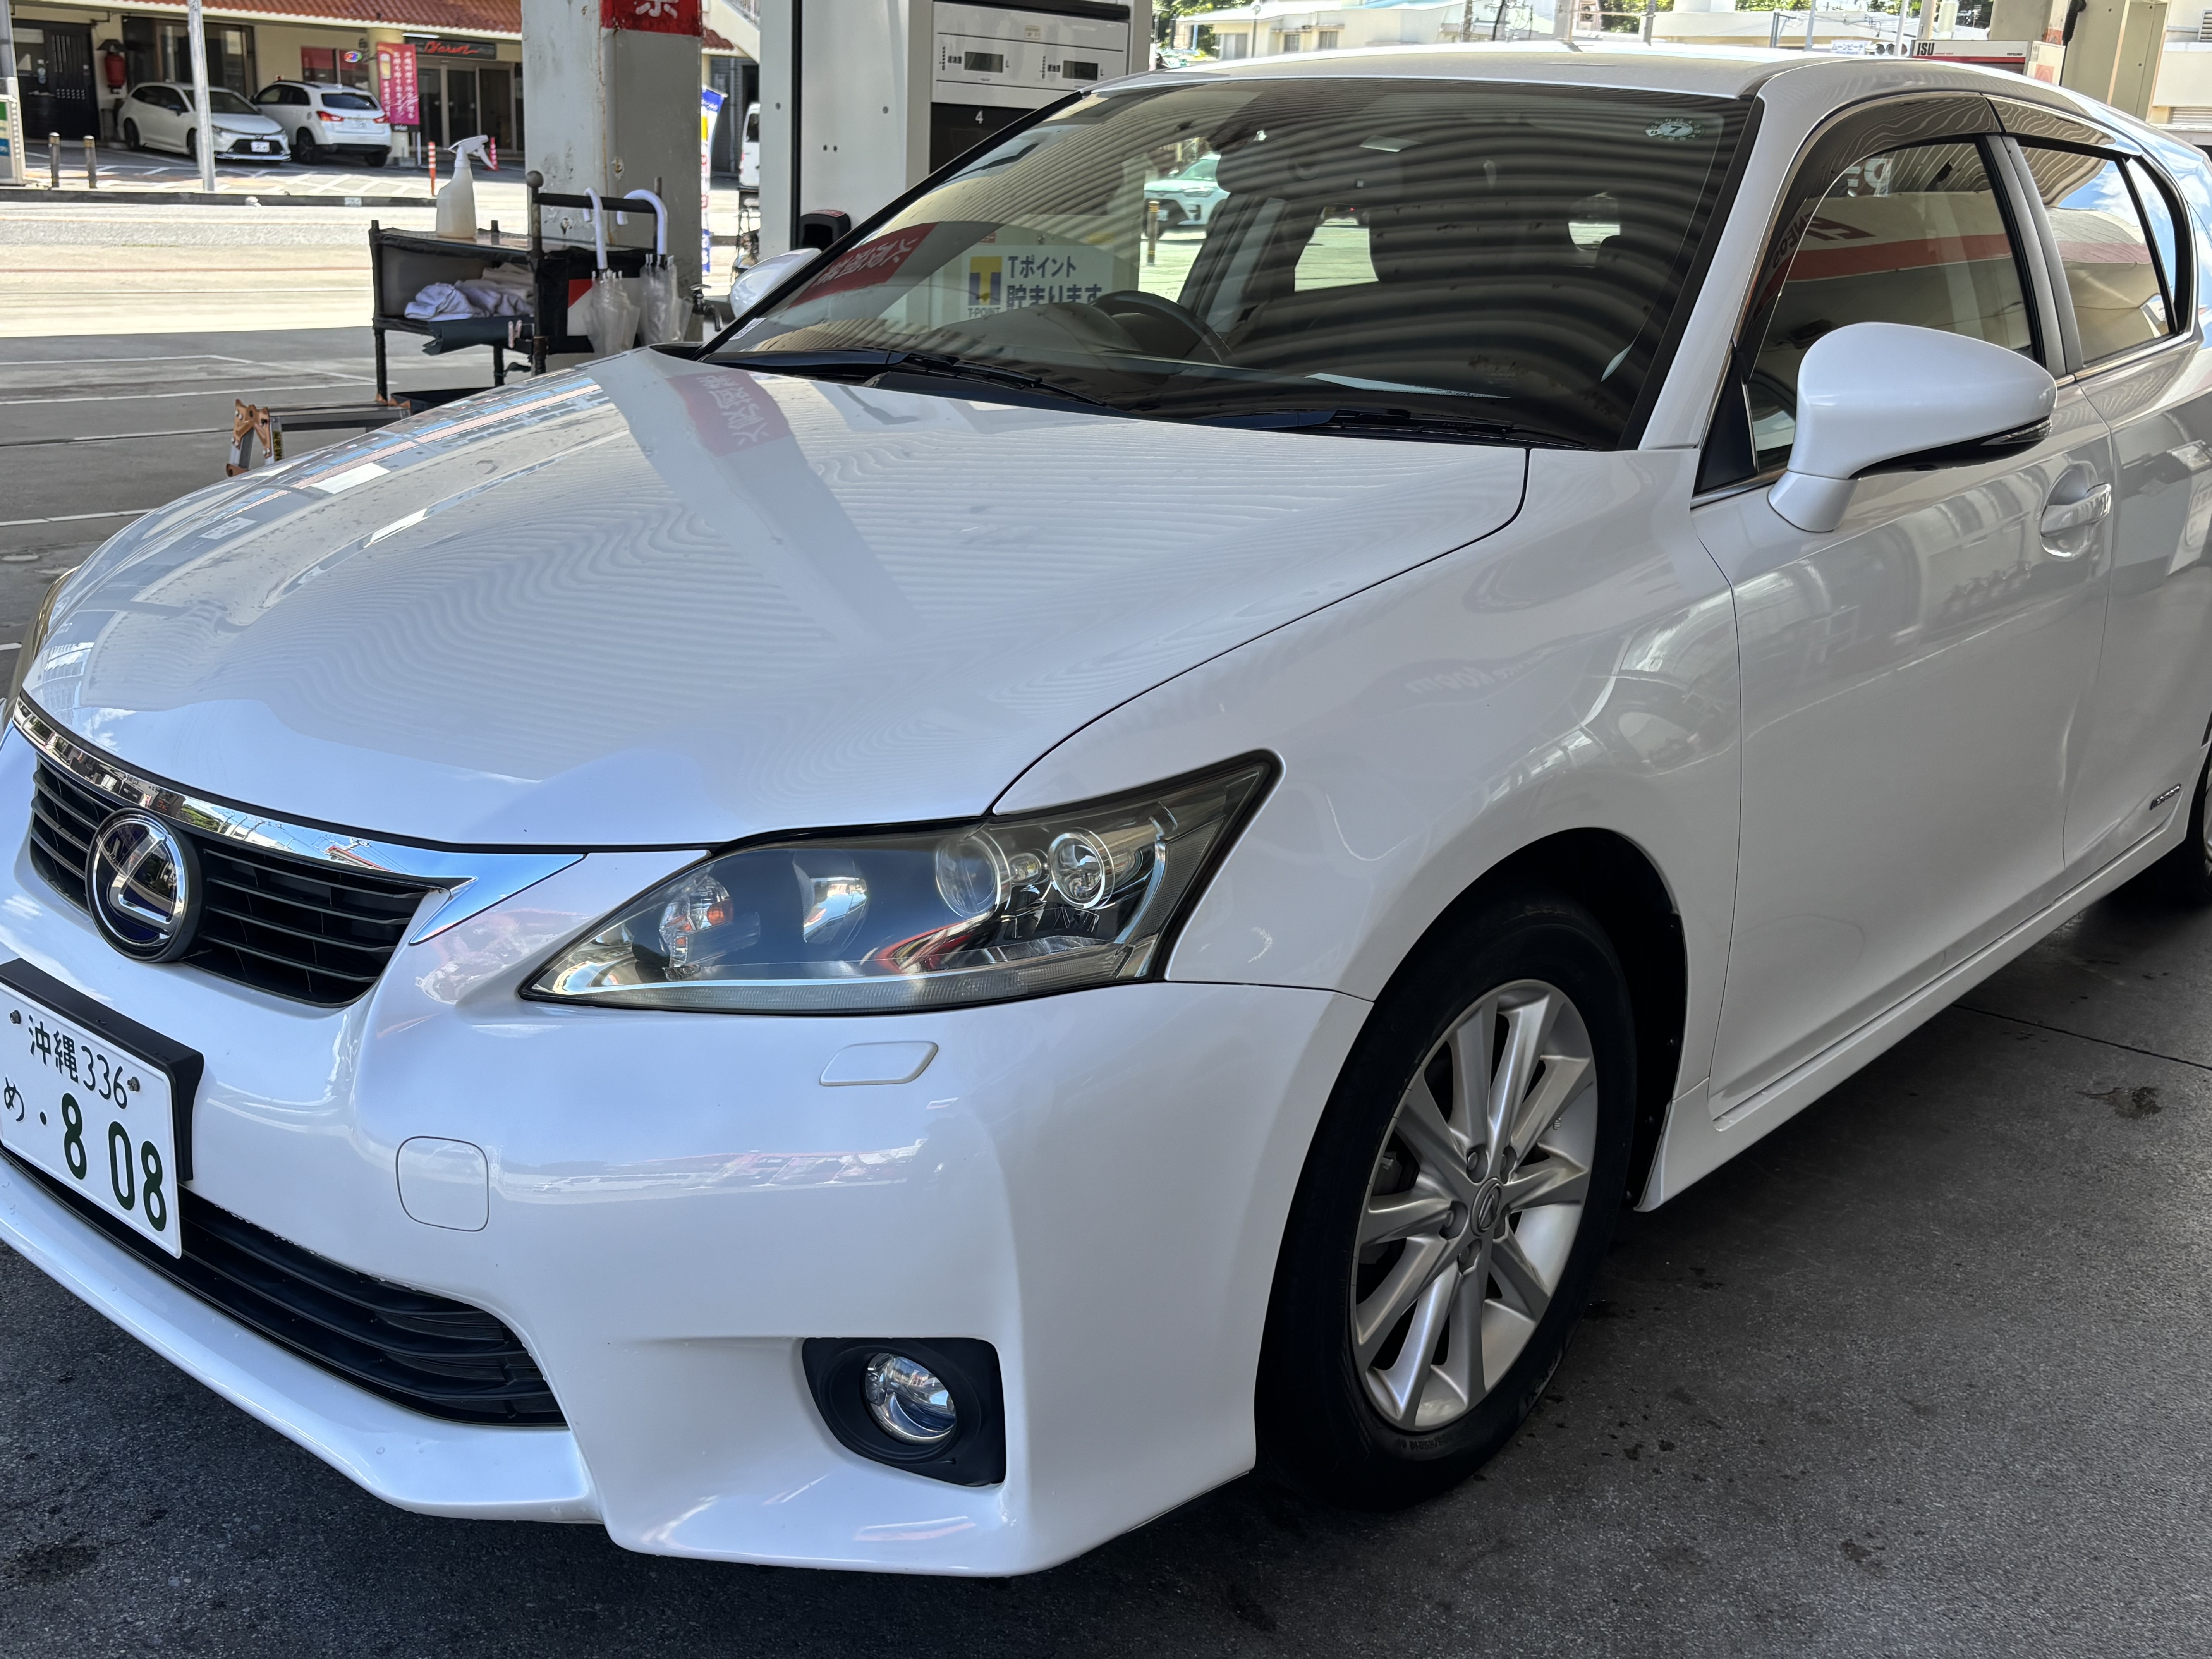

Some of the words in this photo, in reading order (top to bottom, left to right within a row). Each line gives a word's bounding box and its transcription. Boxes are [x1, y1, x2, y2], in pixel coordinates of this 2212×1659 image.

[1917, 42, 1935, 56] ISU
[975, 110, 984, 124] 4
[1008, 254, 1077, 278] Tポイント
